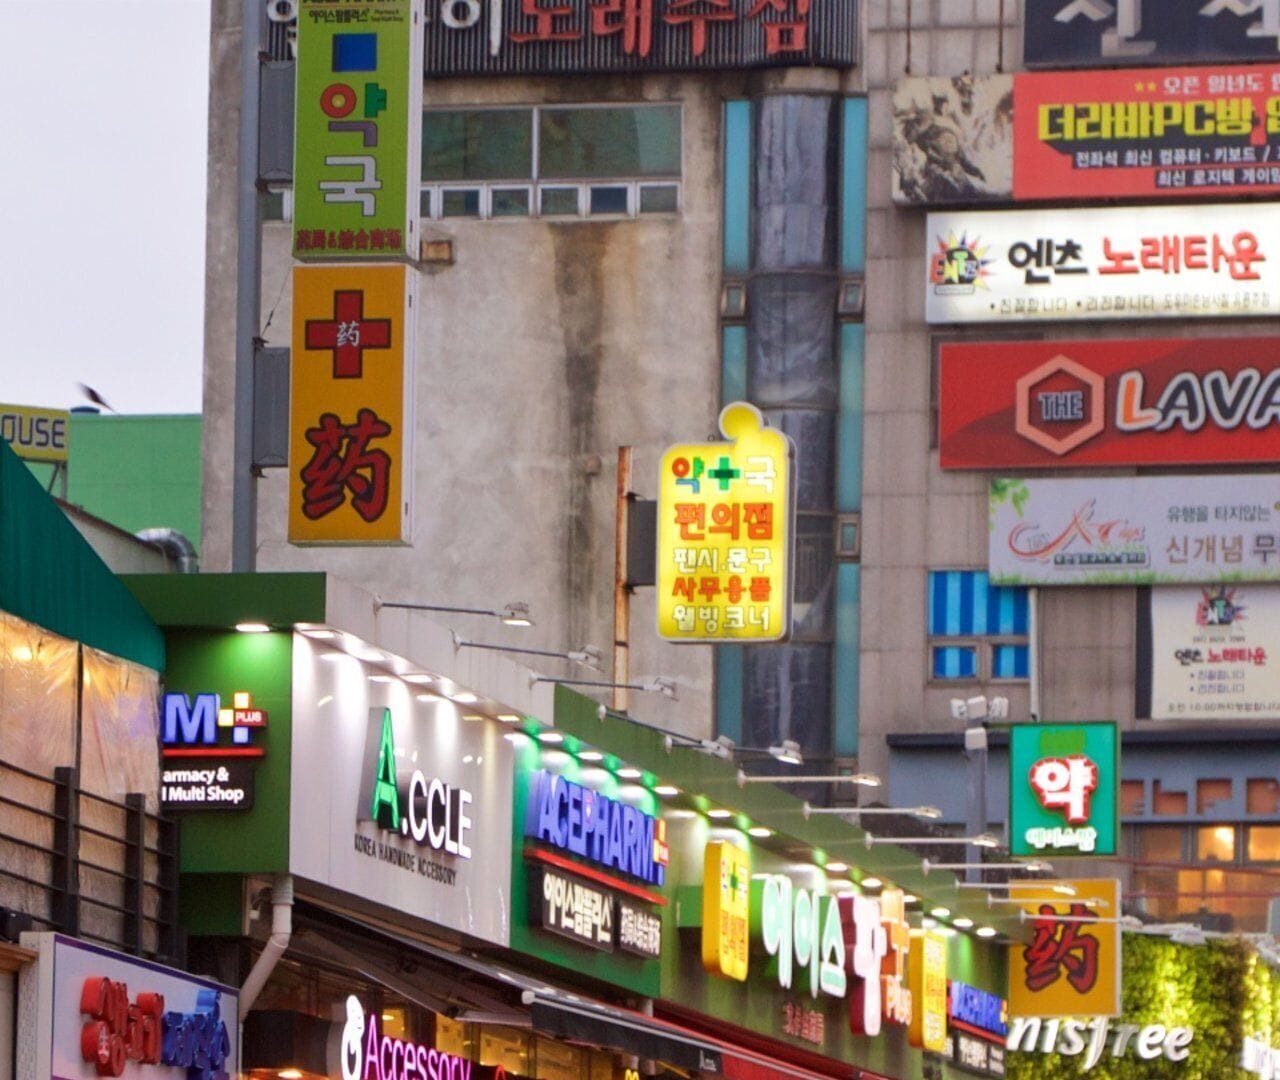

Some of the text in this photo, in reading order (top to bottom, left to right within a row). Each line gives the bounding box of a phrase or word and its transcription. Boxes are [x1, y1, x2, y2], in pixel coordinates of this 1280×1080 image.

[1038, 97, 1257, 140] 더라바PC방
[1008, 231, 1267, 285] 엔츠 노래타운
[336, 320, 361, 347] 药
[1039, 392, 1083, 420] THE
[301, 407, 391, 523] 药
[671, 456, 776, 494] 약 국
[674, 502, 773, 541] 편의점
[1167, 534, 1243, 563] 신개념
[672, 575, 771, 604] 사무용품
[672, 605, 771, 632] 웰빙코너
[235, 711, 262, 723] PLUS
[217, 767, 229, 783] &
[1029, 754, 1098, 824] 약
[168, 786, 205, 802] Multi
[207, 786, 245, 805] Shop
[355, 833, 458, 888] KOREA HANDMADE ACCESSORY
[1023, 903, 1100, 995] 药
